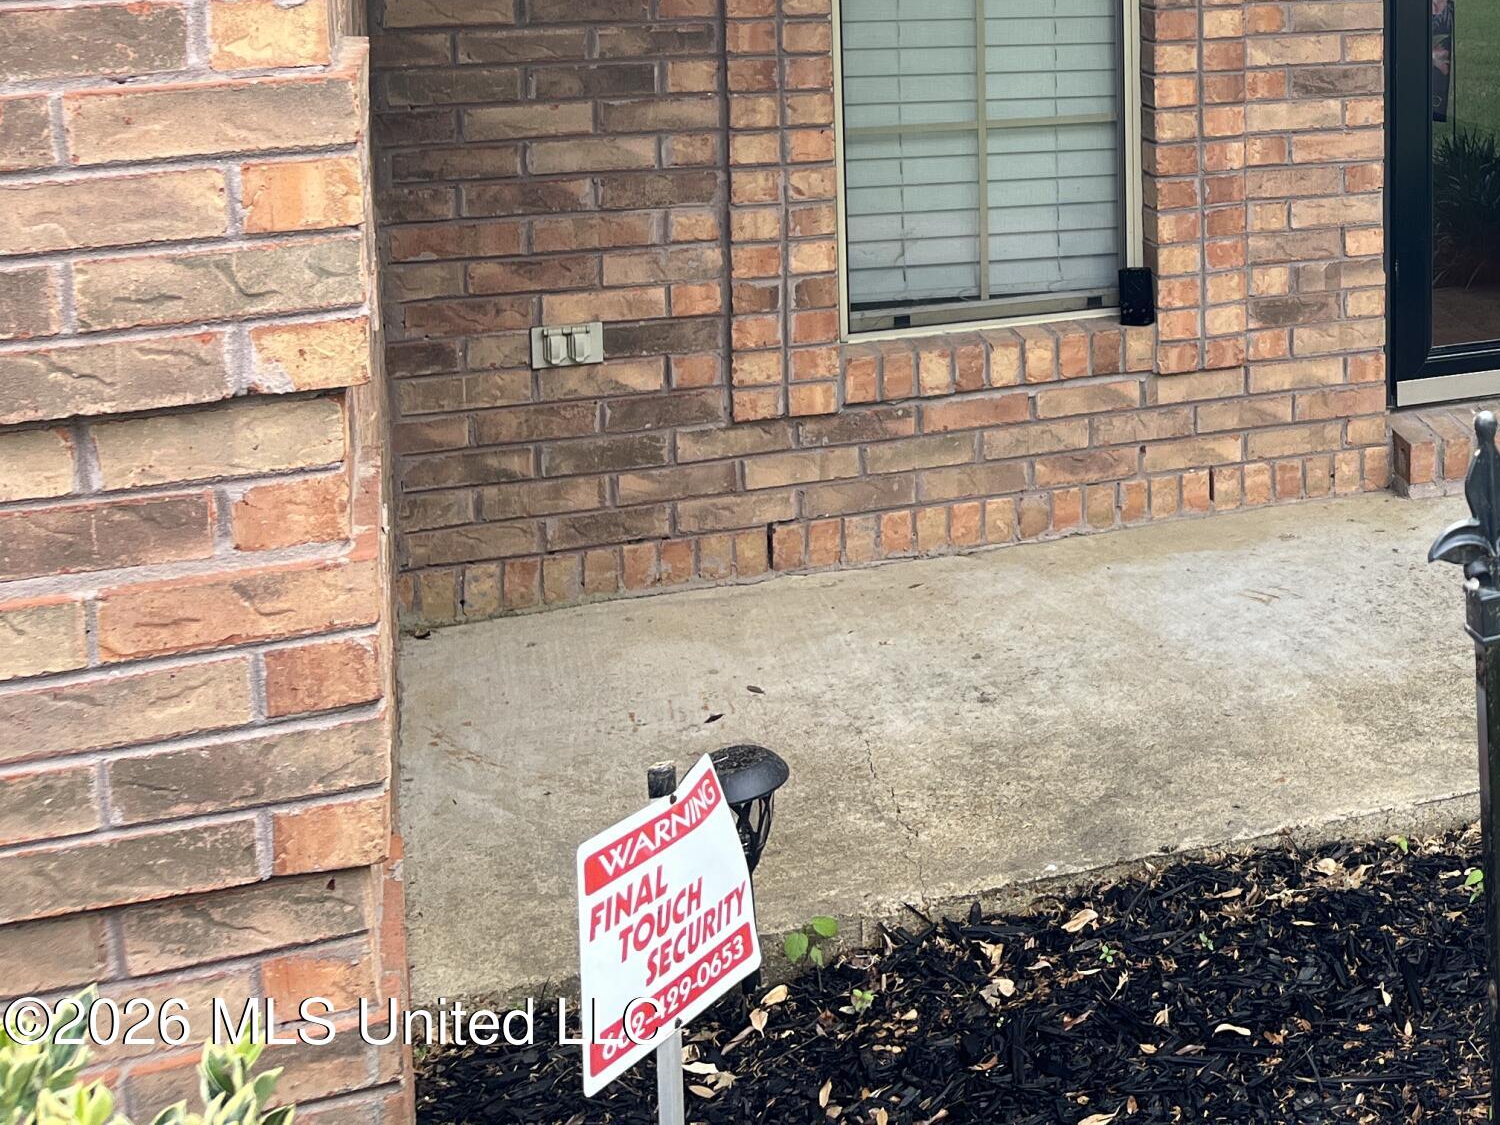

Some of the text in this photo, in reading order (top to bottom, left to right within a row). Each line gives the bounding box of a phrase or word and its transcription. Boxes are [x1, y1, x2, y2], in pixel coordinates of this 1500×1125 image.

[598, 779, 716, 876] WARNING
[589, 864, 669, 942] FINAL
[618, 876, 703, 963] TOUCH
[646, 880, 746, 987] SECURITY
